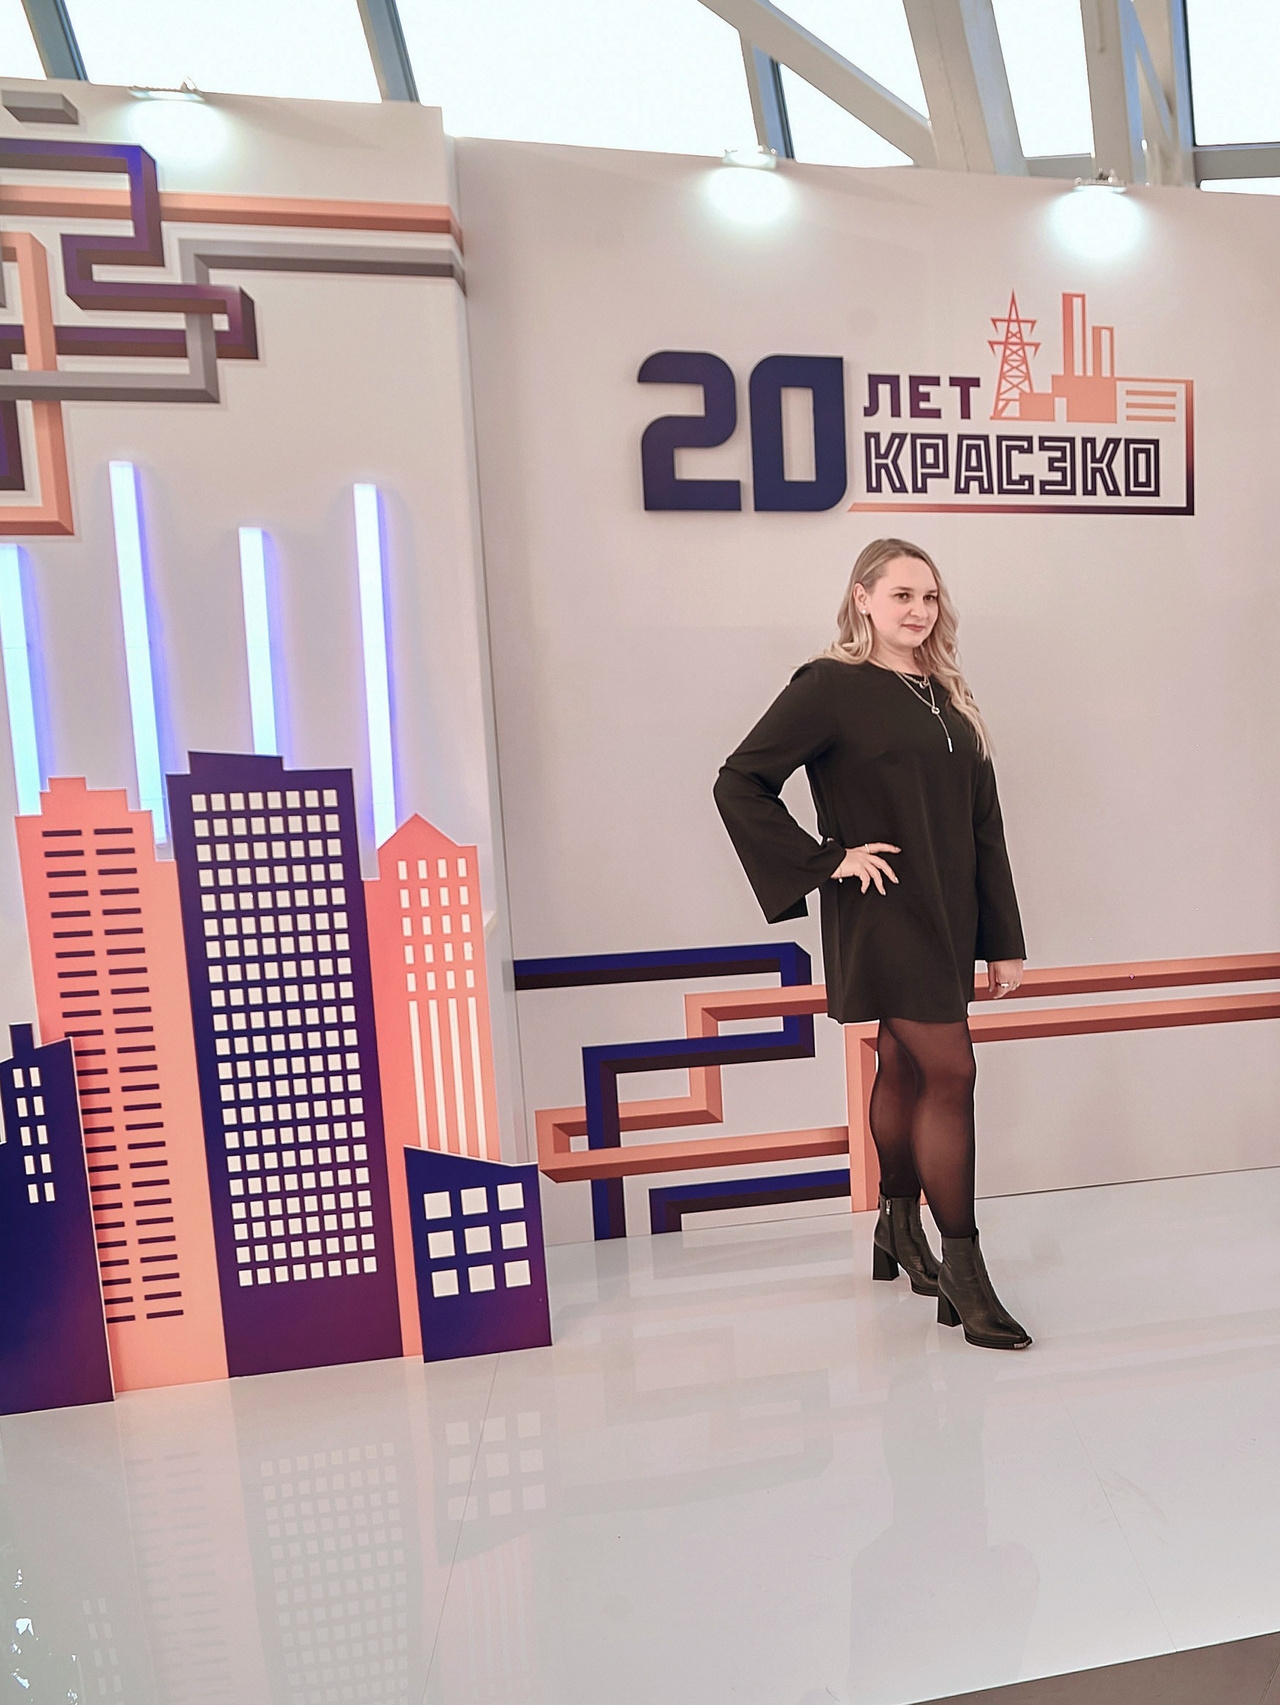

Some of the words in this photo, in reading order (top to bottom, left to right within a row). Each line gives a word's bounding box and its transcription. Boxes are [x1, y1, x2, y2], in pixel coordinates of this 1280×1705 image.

[637, 350, 847, 511] 20
[863, 373, 980, 420] ЛЕТ
[864, 431, 1160, 497] КРАСЭКО
